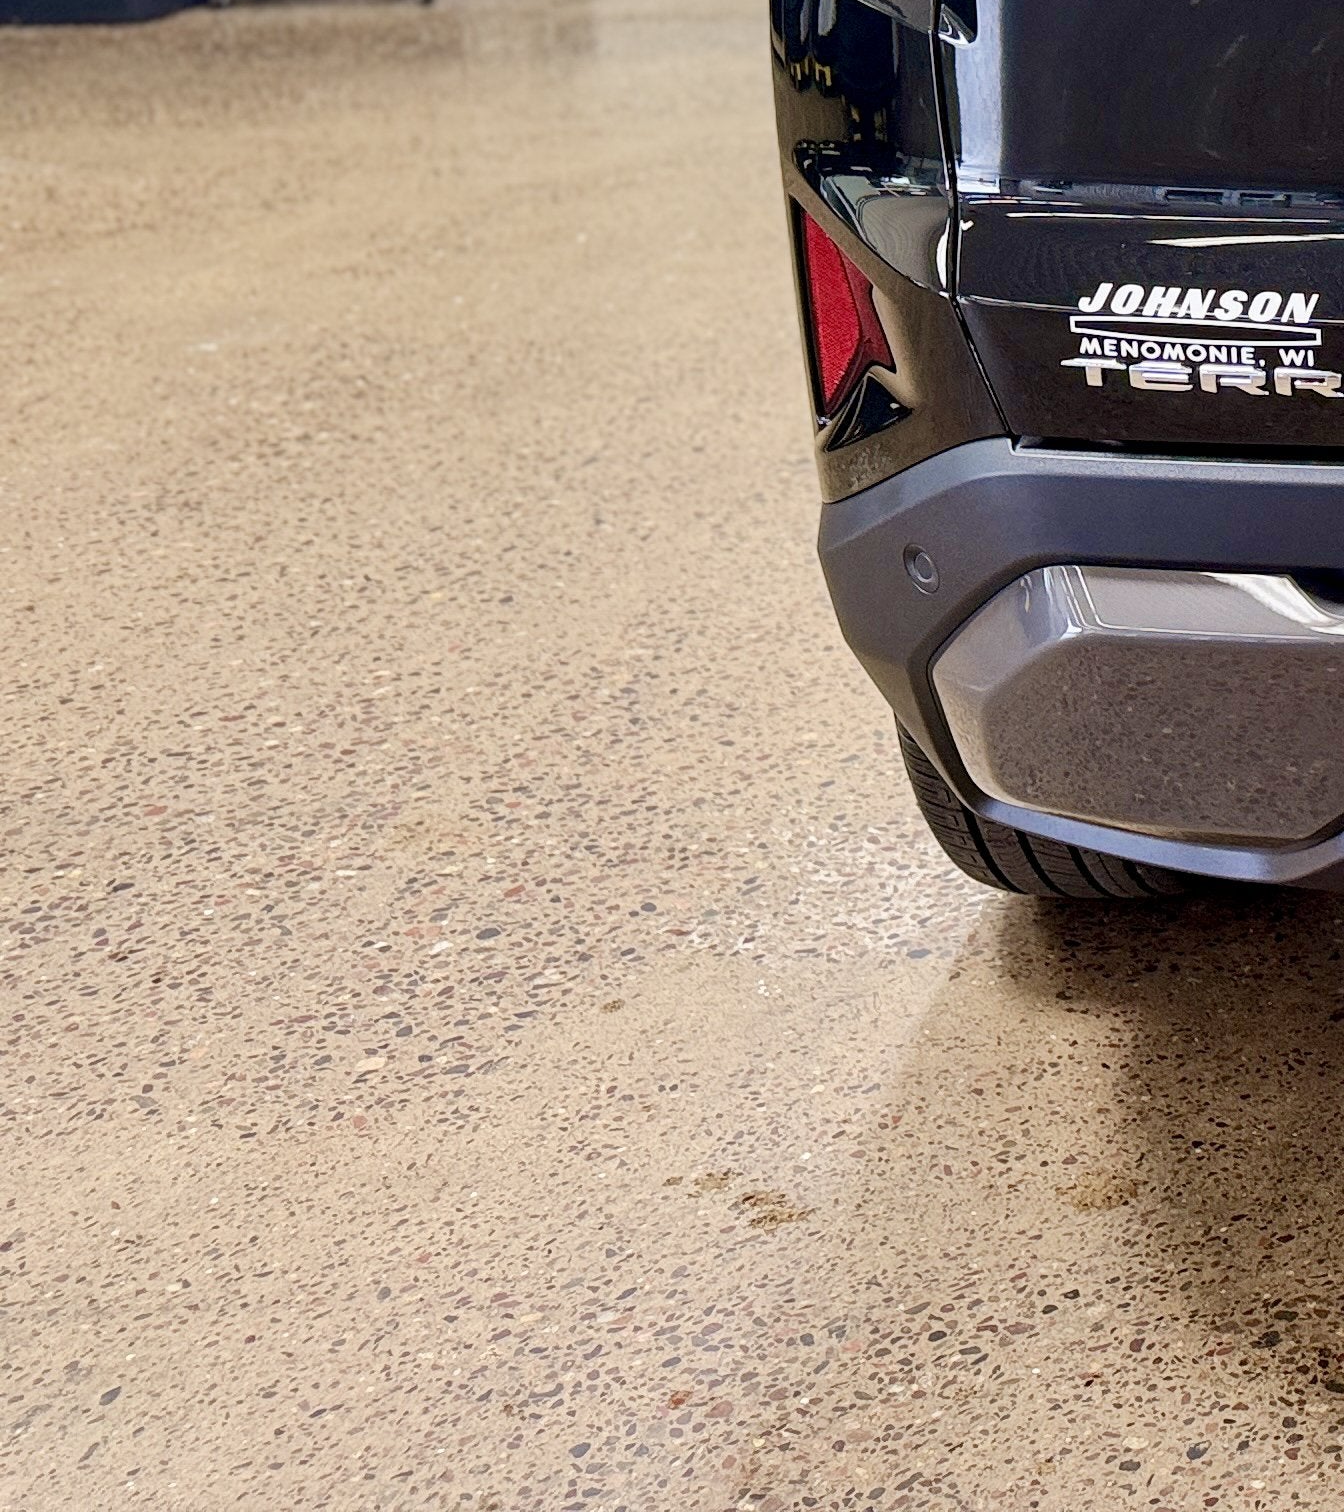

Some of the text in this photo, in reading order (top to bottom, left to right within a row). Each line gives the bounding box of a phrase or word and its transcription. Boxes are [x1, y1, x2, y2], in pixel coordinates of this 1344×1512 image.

[1078, 282, 1320, 324] JOHNSON
[1079, 337, 1315, 367] MENOMONIE, WI
